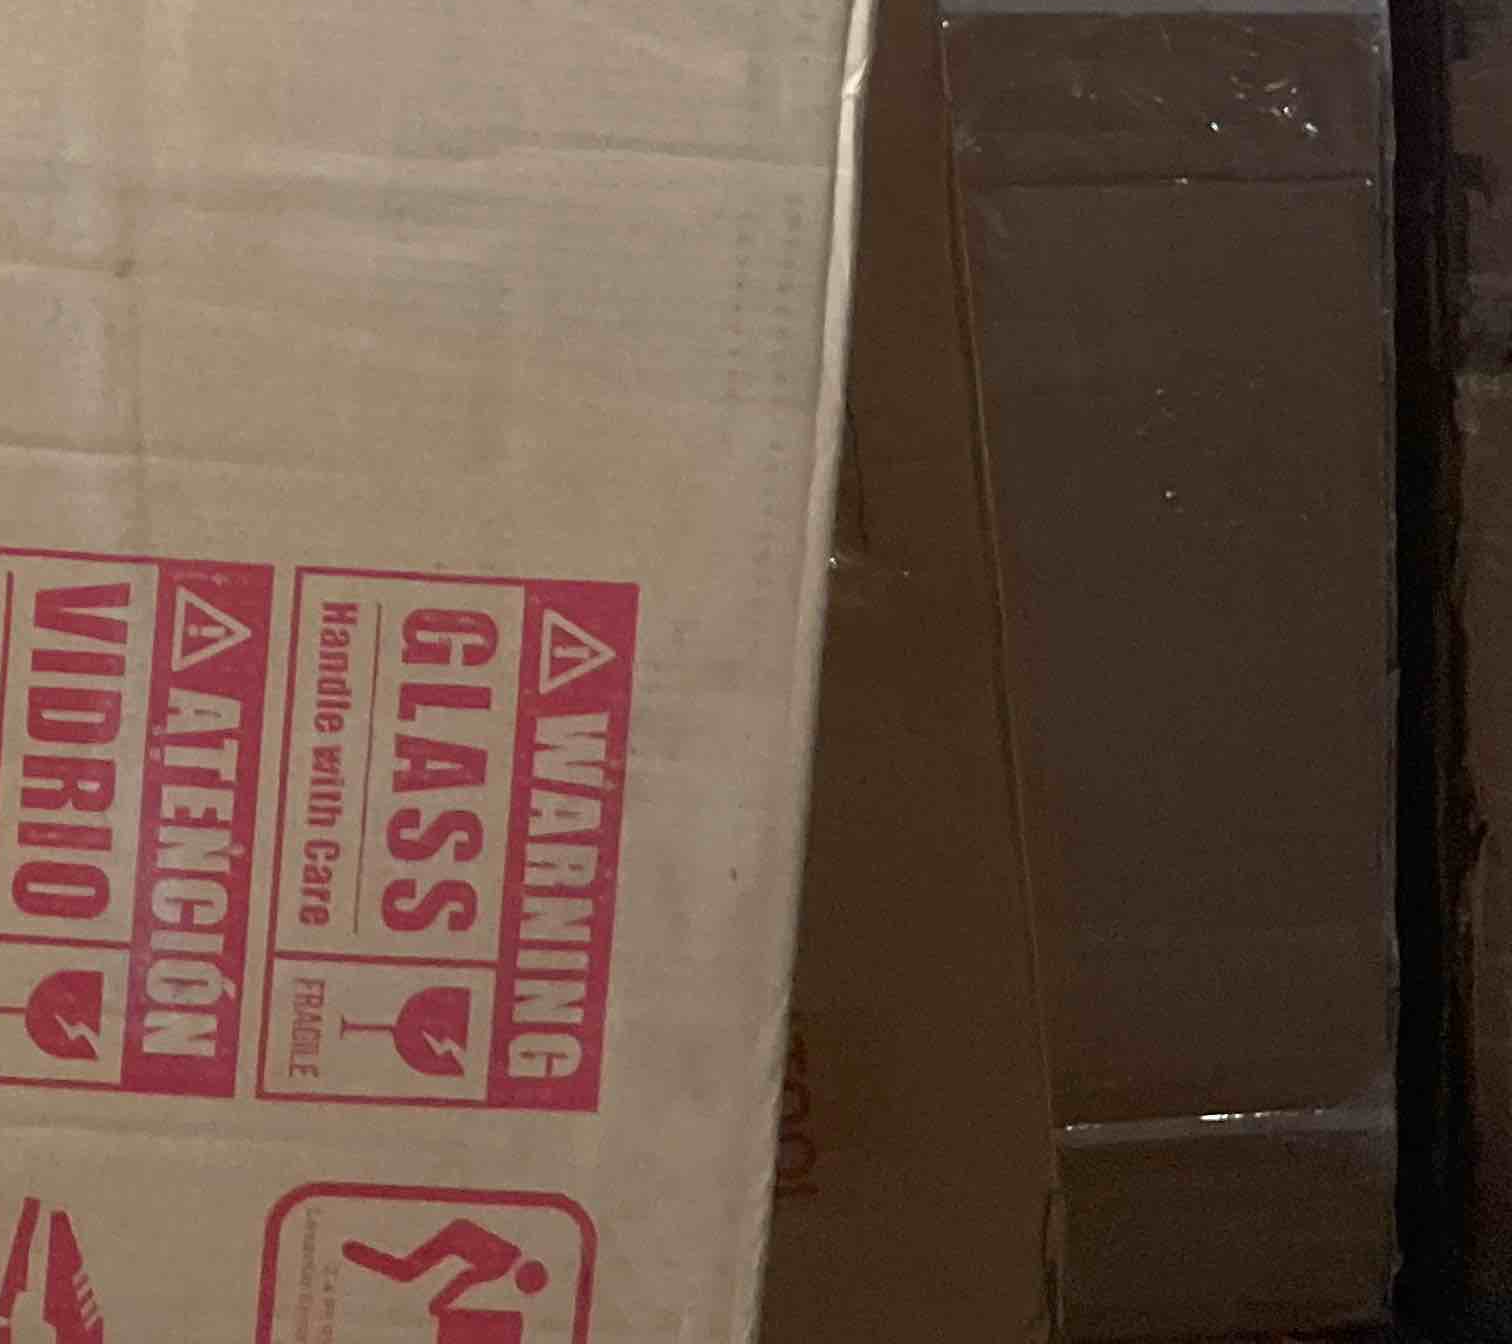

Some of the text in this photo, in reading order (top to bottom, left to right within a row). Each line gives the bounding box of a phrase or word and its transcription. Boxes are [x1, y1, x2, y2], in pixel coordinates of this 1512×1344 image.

[11, 582, 131, 920] VIDRIO
[143, 687, 243, 1057] ATENCIÓN
[298, 600, 359, 928] Handle with Care
[380, 608, 500, 934] GLASS
[507, 712, 611, 1080] WARNING
[288, 977, 326, 1079] FRAGILE
